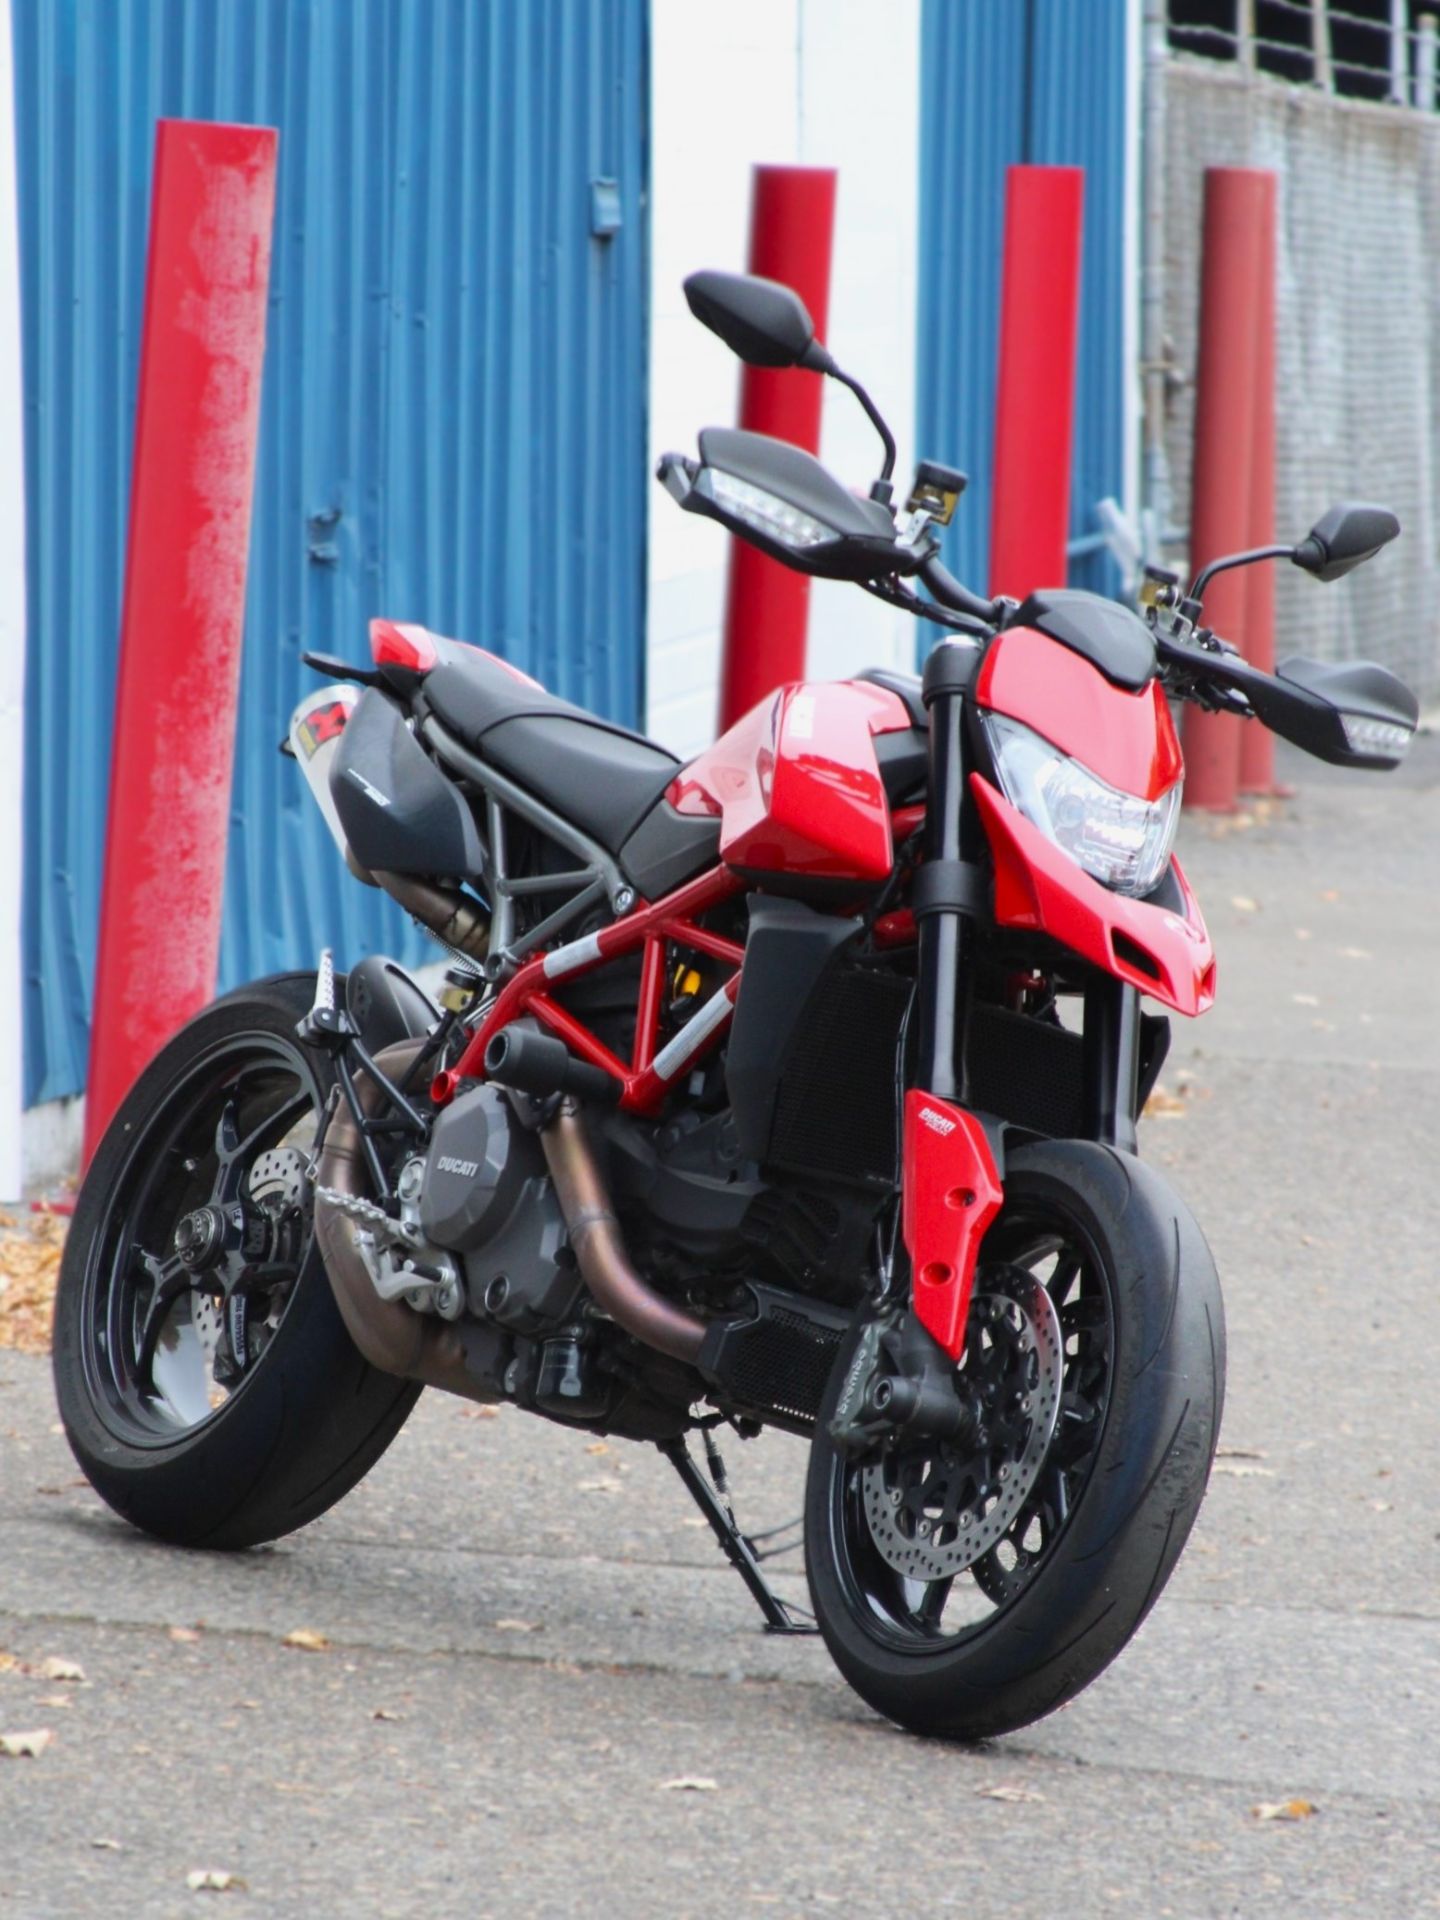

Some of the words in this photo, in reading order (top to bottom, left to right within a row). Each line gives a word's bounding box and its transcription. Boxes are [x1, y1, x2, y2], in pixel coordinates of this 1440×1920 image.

[919, 1107, 956, 1130] DUCATI
[437, 1156, 478, 1178] DUCATI
[837, 1349, 866, 1415] brembo
